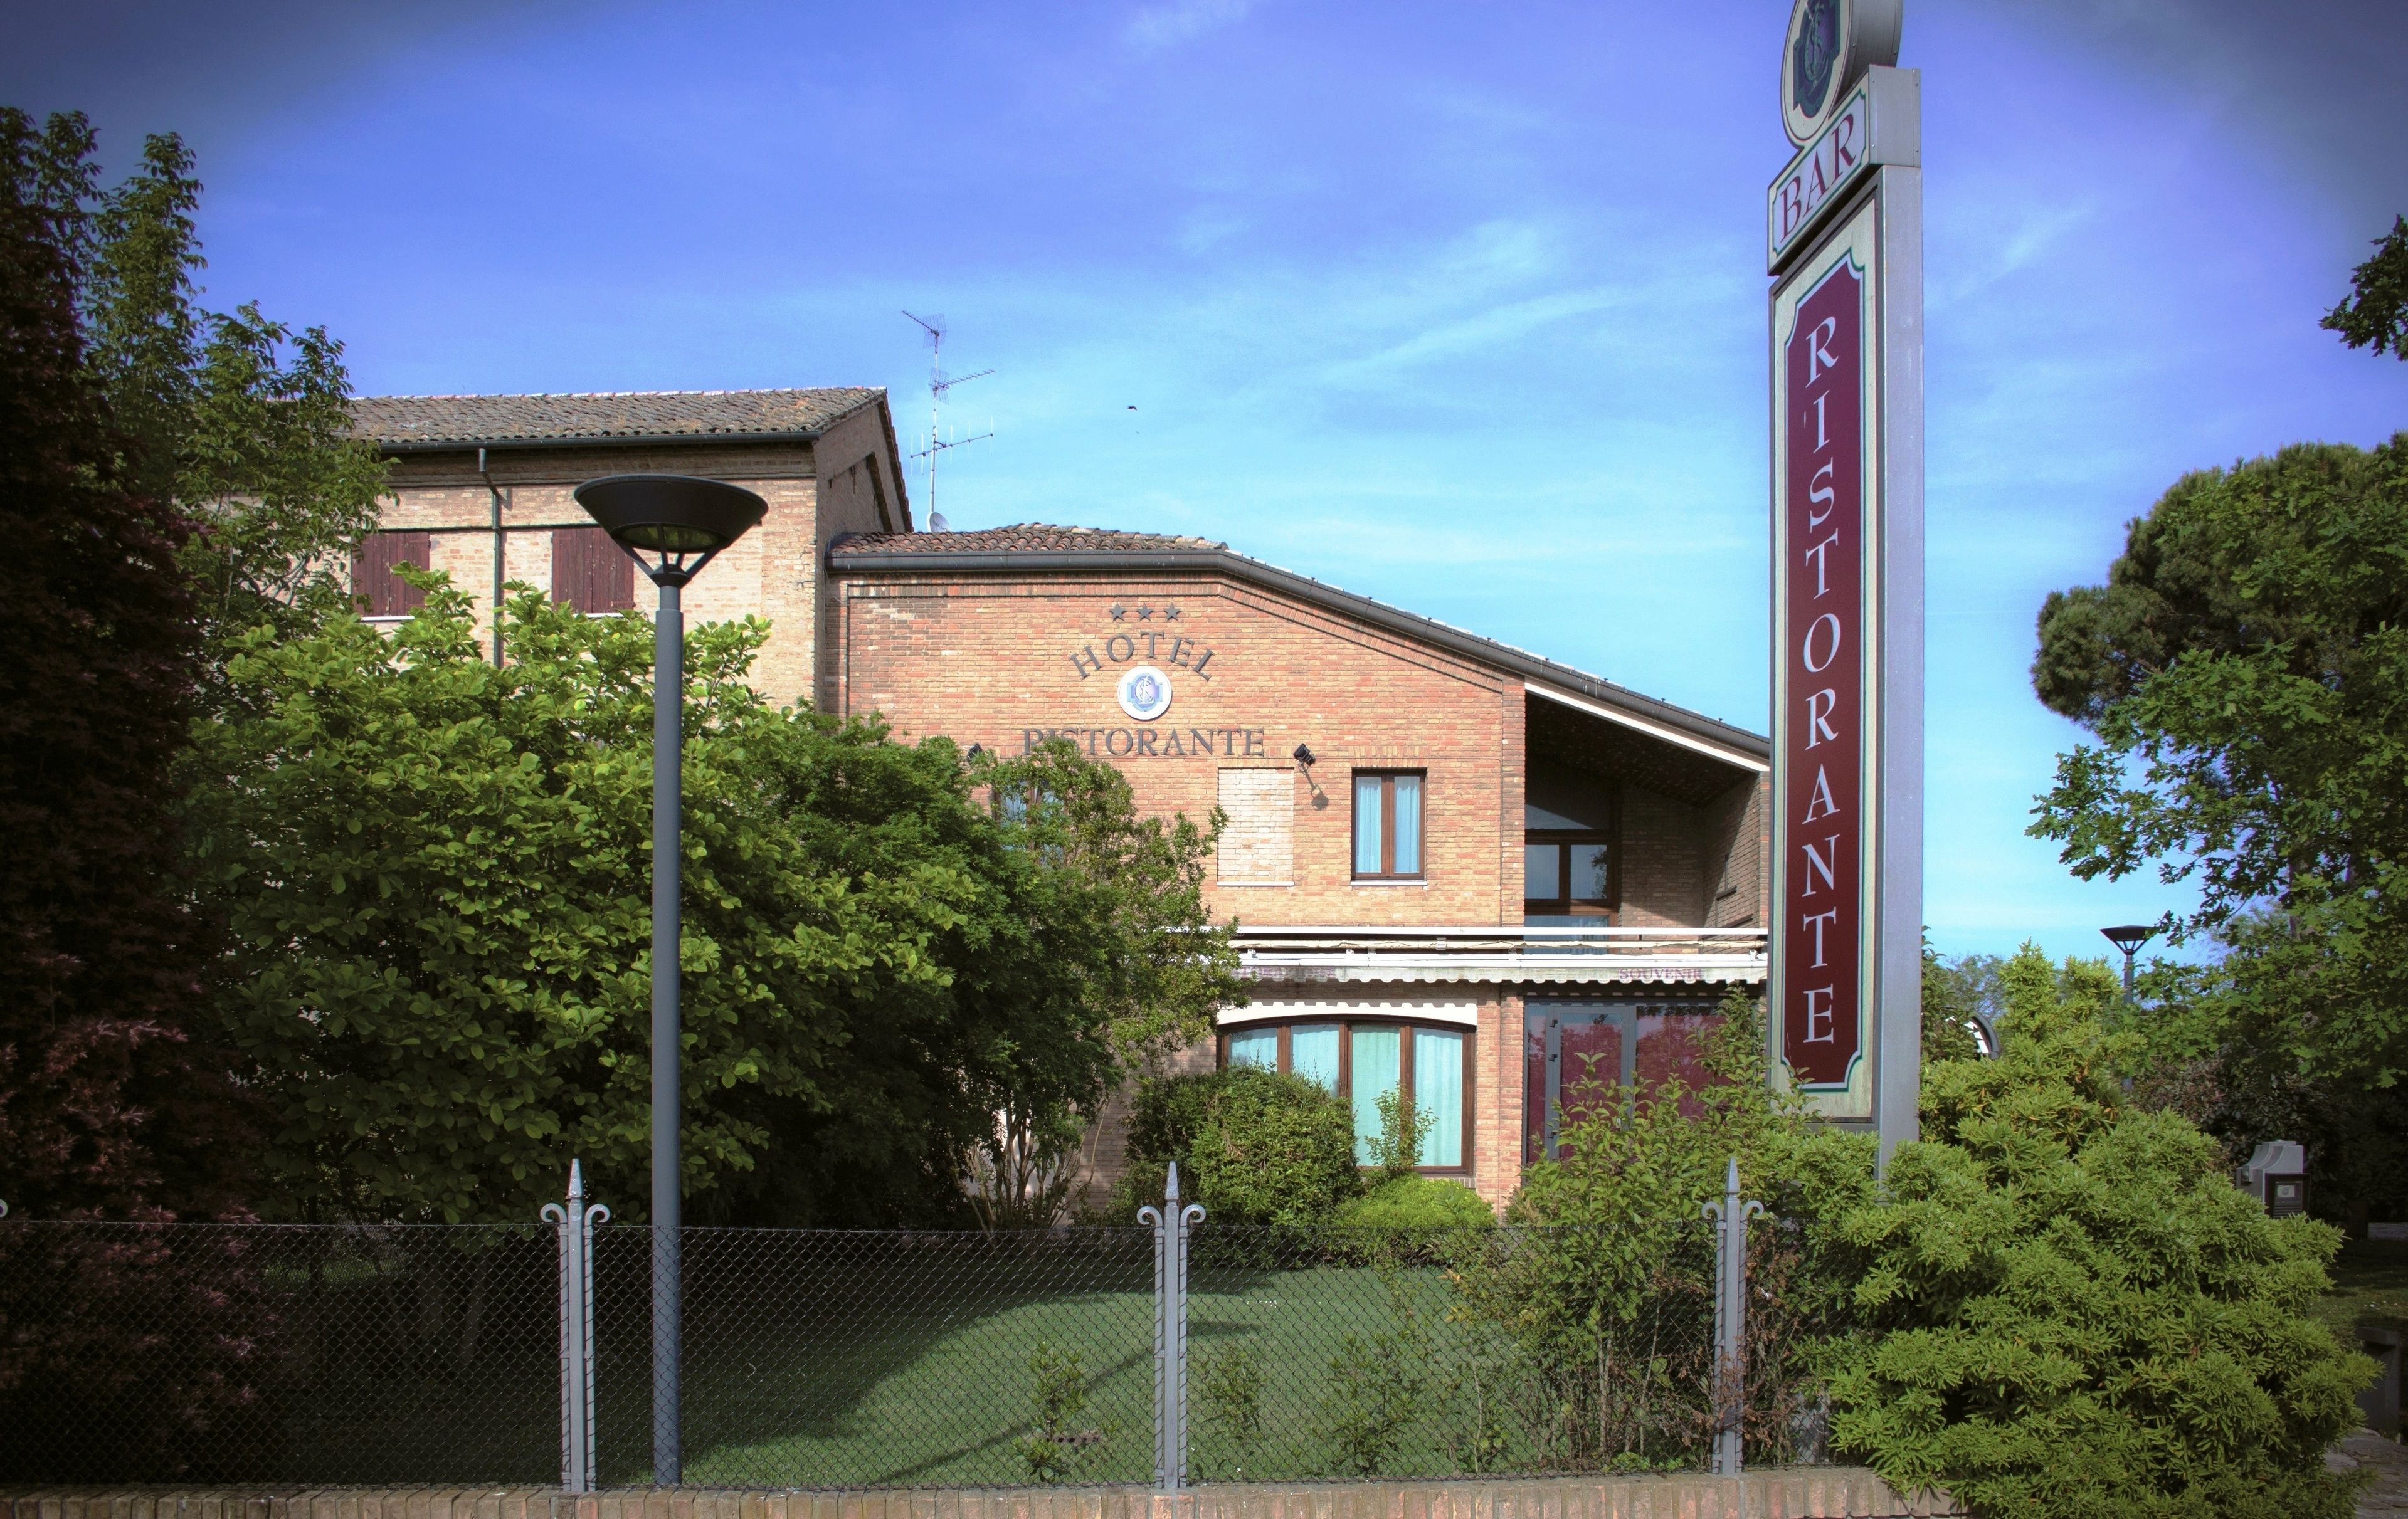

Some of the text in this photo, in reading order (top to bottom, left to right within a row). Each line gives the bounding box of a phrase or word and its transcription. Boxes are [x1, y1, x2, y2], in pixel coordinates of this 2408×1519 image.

[1780, 113, 1857, 244] BAR
[1068, 631, 1216, 681] HOTEL
[1801, 316, 1841, 1044] RISTORANTE
[1619, 968, 1704, 979] SOUVENIR
